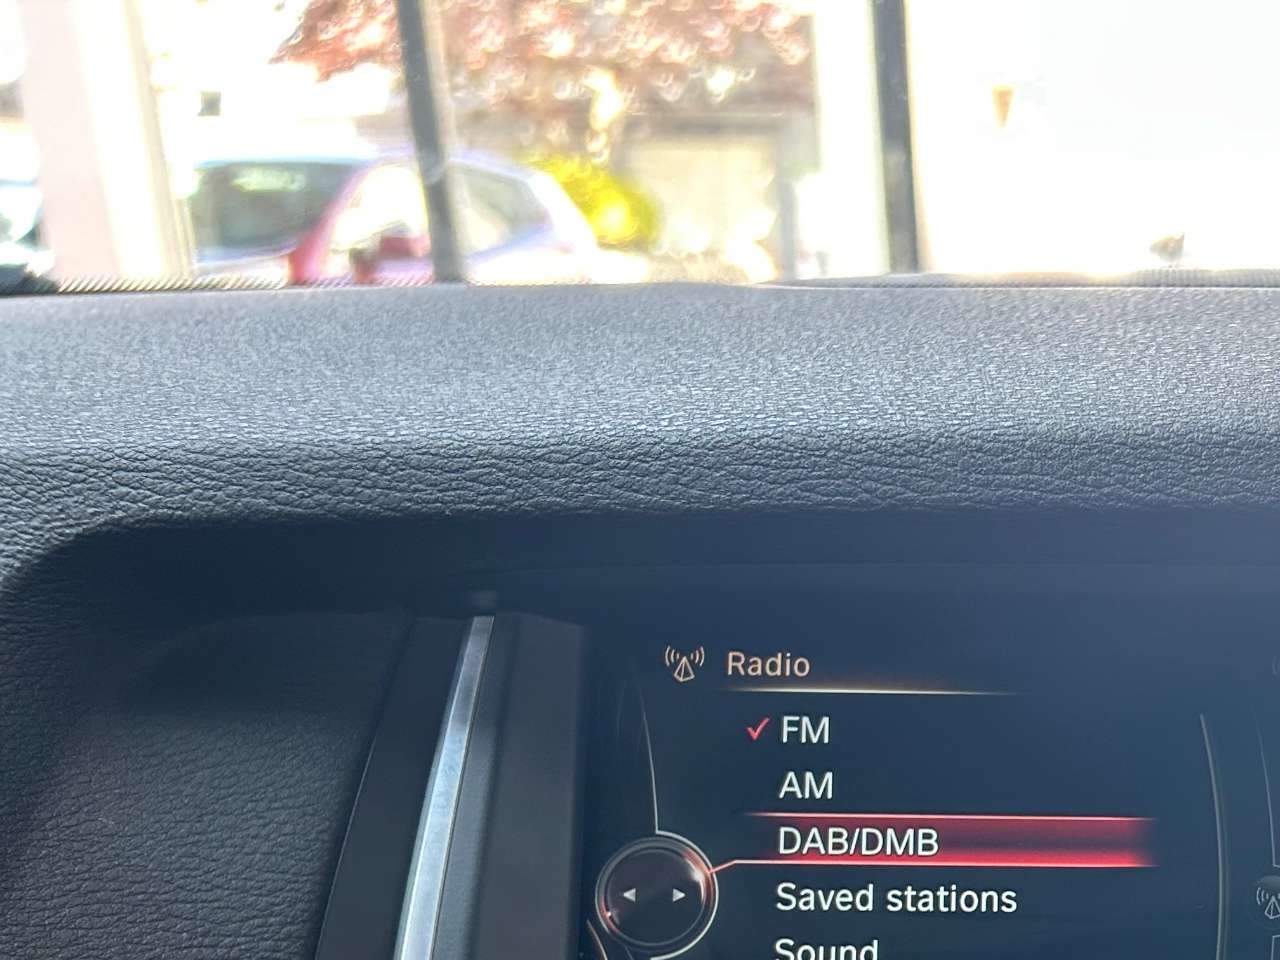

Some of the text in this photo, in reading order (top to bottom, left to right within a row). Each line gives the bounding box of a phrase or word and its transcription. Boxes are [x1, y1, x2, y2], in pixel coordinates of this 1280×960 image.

[726, 650, 811, 678] Radio
[781, 715, 831, 744] FM
[778, 771, 834, 800] AM
[778, 826, 940, 857] DAB/DMB
[776, 882, 1018, 914] Saved stations
